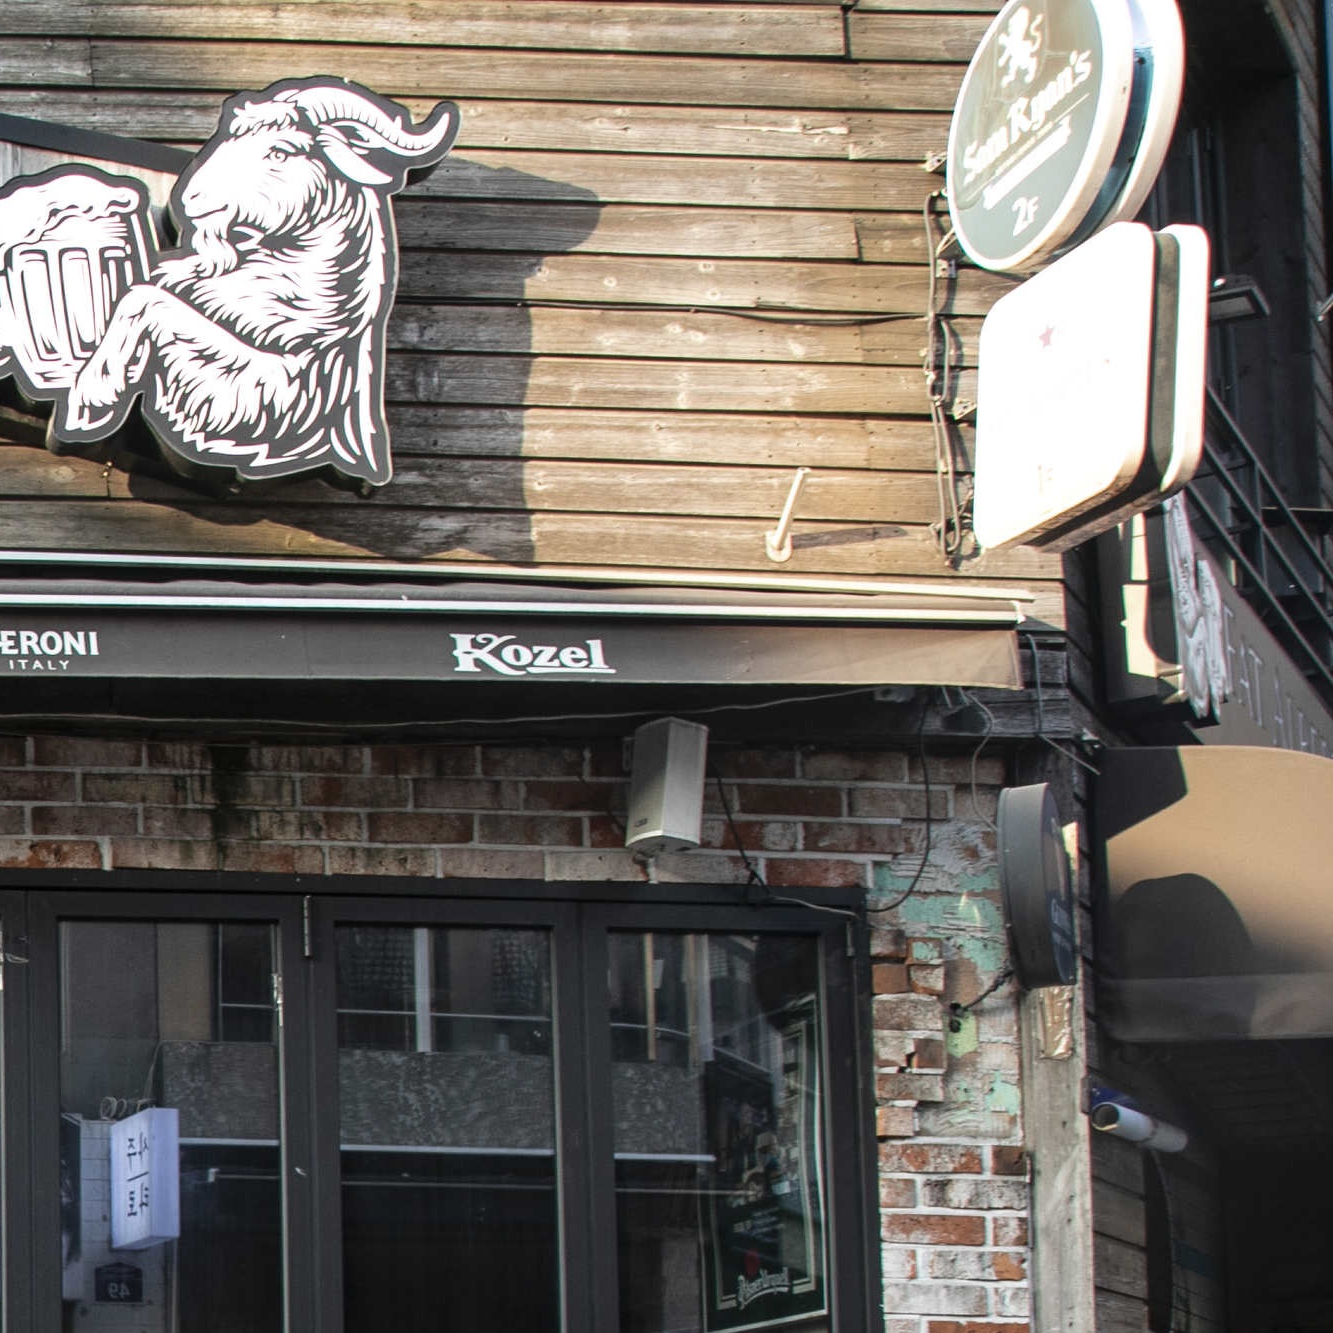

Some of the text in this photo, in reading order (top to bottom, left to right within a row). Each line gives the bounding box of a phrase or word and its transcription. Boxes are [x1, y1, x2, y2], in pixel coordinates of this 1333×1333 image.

[963, 126, 1011, 187] Sam
[1006, 50, 1092, 145] Ryan's
[1012, 196, 1039, 237] 2F
[9, 659, 71, 671] ITALY
[450, 632, 617, 674] Kozel
